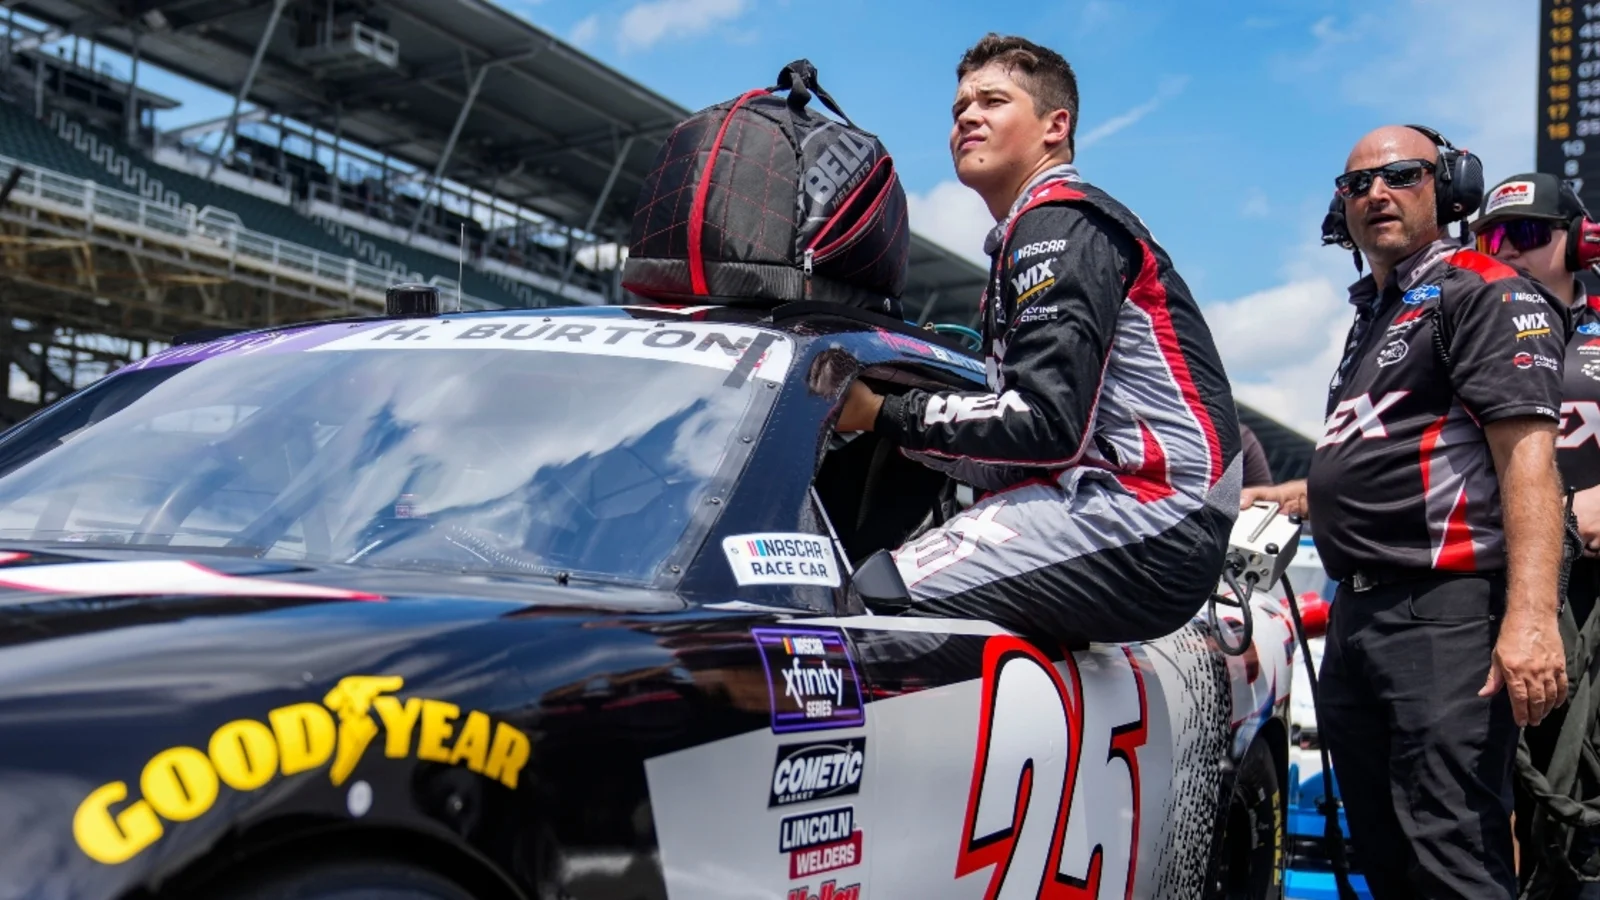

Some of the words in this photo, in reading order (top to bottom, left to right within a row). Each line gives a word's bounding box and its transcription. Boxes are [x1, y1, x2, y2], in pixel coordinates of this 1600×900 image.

[805, 132, 869, 206] BELL
[1017, 239, 1067, 258] NASCAR
[1011, 257, 1055, 295] WIX
[371, 325, 430, 341] H.
[456, 322, 754, 356] BURTON
[1512, 312, 1549, 332] WIX
[1316, 390, 1410, 450] EX
[1555, 401, 1600, 447] EX
[763, 539, 824, 559] NASCAR
[894, 499, 1021, 589] EX
[751, 562, 795, 576] RACE
[799, 563, 828, 577] CAR
[781, 657, 843, 709] xfinity
[806, 700, 833, 718] SERIES
[72, 675, 531, 865] GOODYEAR
[773, 750, 863, 795] COMETIC
[778, 791, 814, 803] GASKET
[782, 811, 850, 849] LINCOLN
[796, 843, 856, 875] WELDERS
